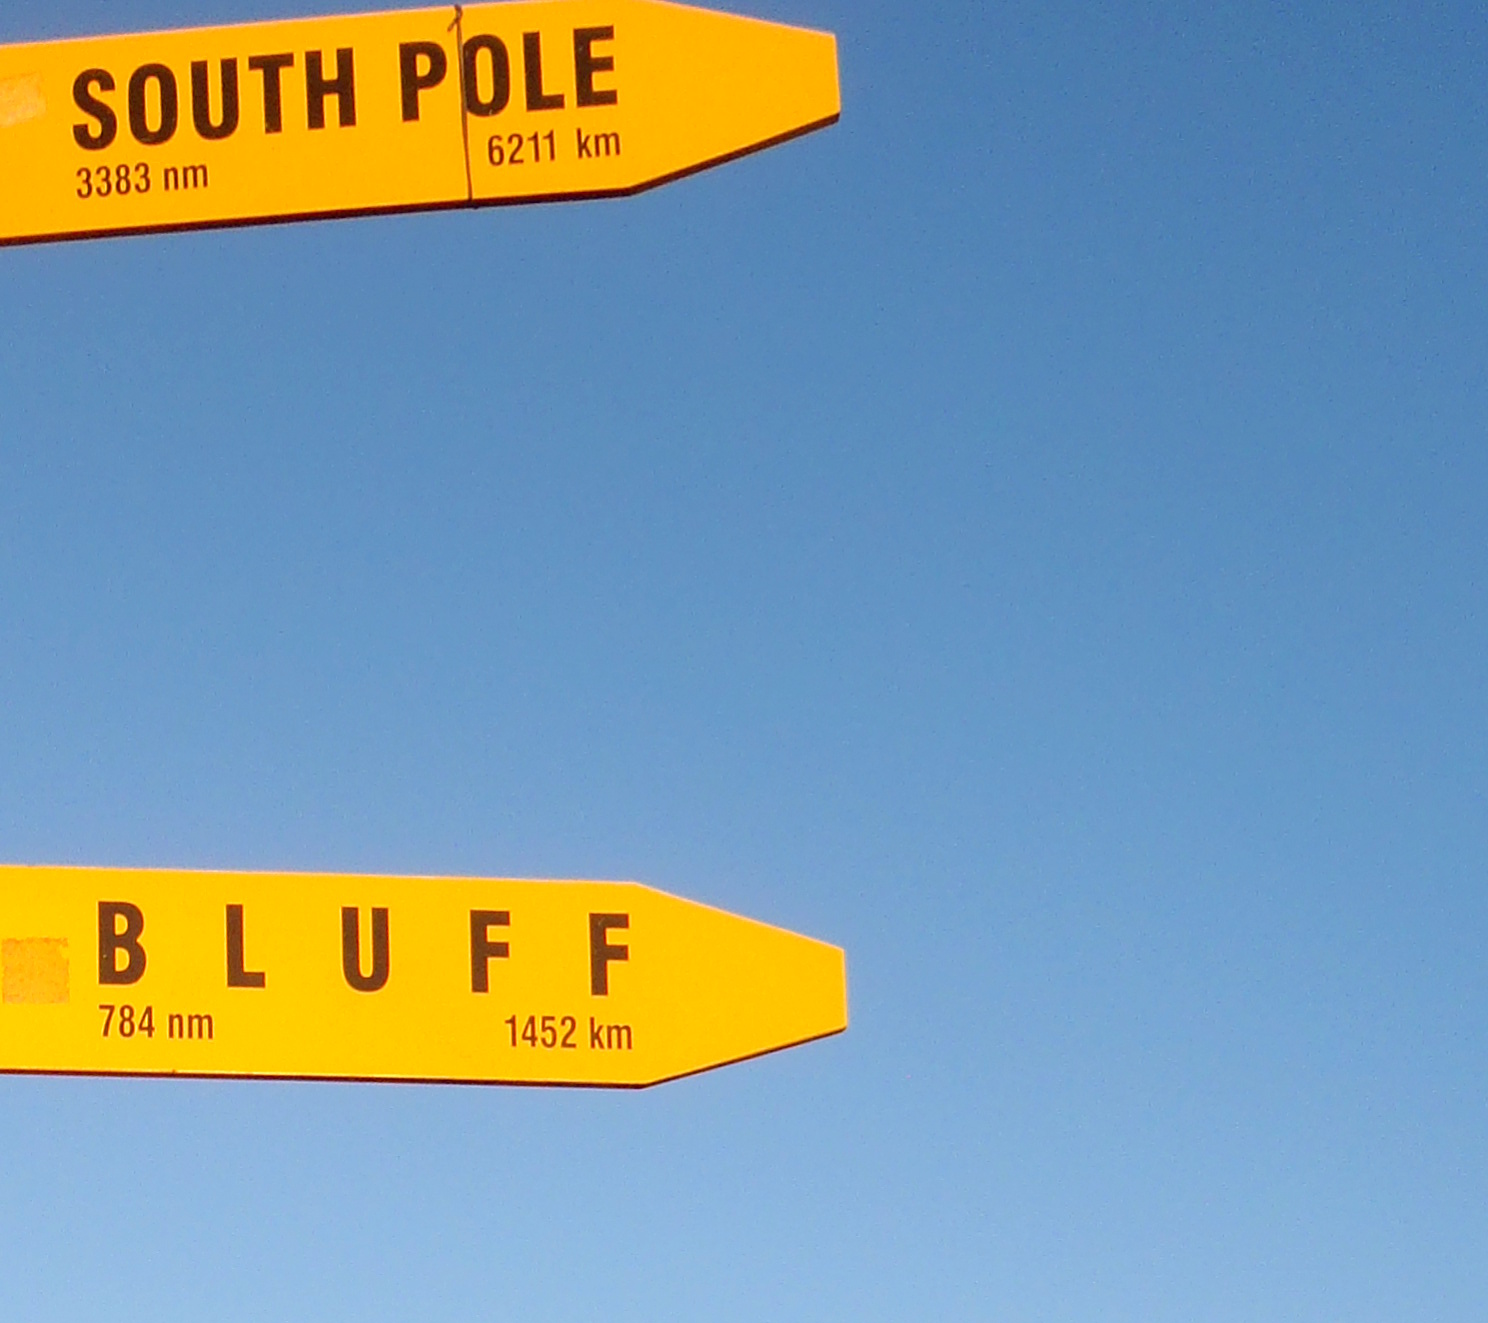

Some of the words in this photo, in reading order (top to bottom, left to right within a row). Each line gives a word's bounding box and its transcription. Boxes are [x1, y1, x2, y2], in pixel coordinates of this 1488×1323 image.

[72, 47, 356, 151] SOUTH
[400, 25, 619, 121] POLE
[488, 131, 555, 166] 6211
[576, 128, 621, 159] km
[76, 163, 151, 199] 3383
[163, 164, 208, 191] nm
[98, 901, 630, 996] BLUFF
[99, 1004, 155, 1038] 784
[168, 1013, 214, 1039] nm
[505, 1015, 577, 1049] 1452
[589, 1016, 632, 1050] km
